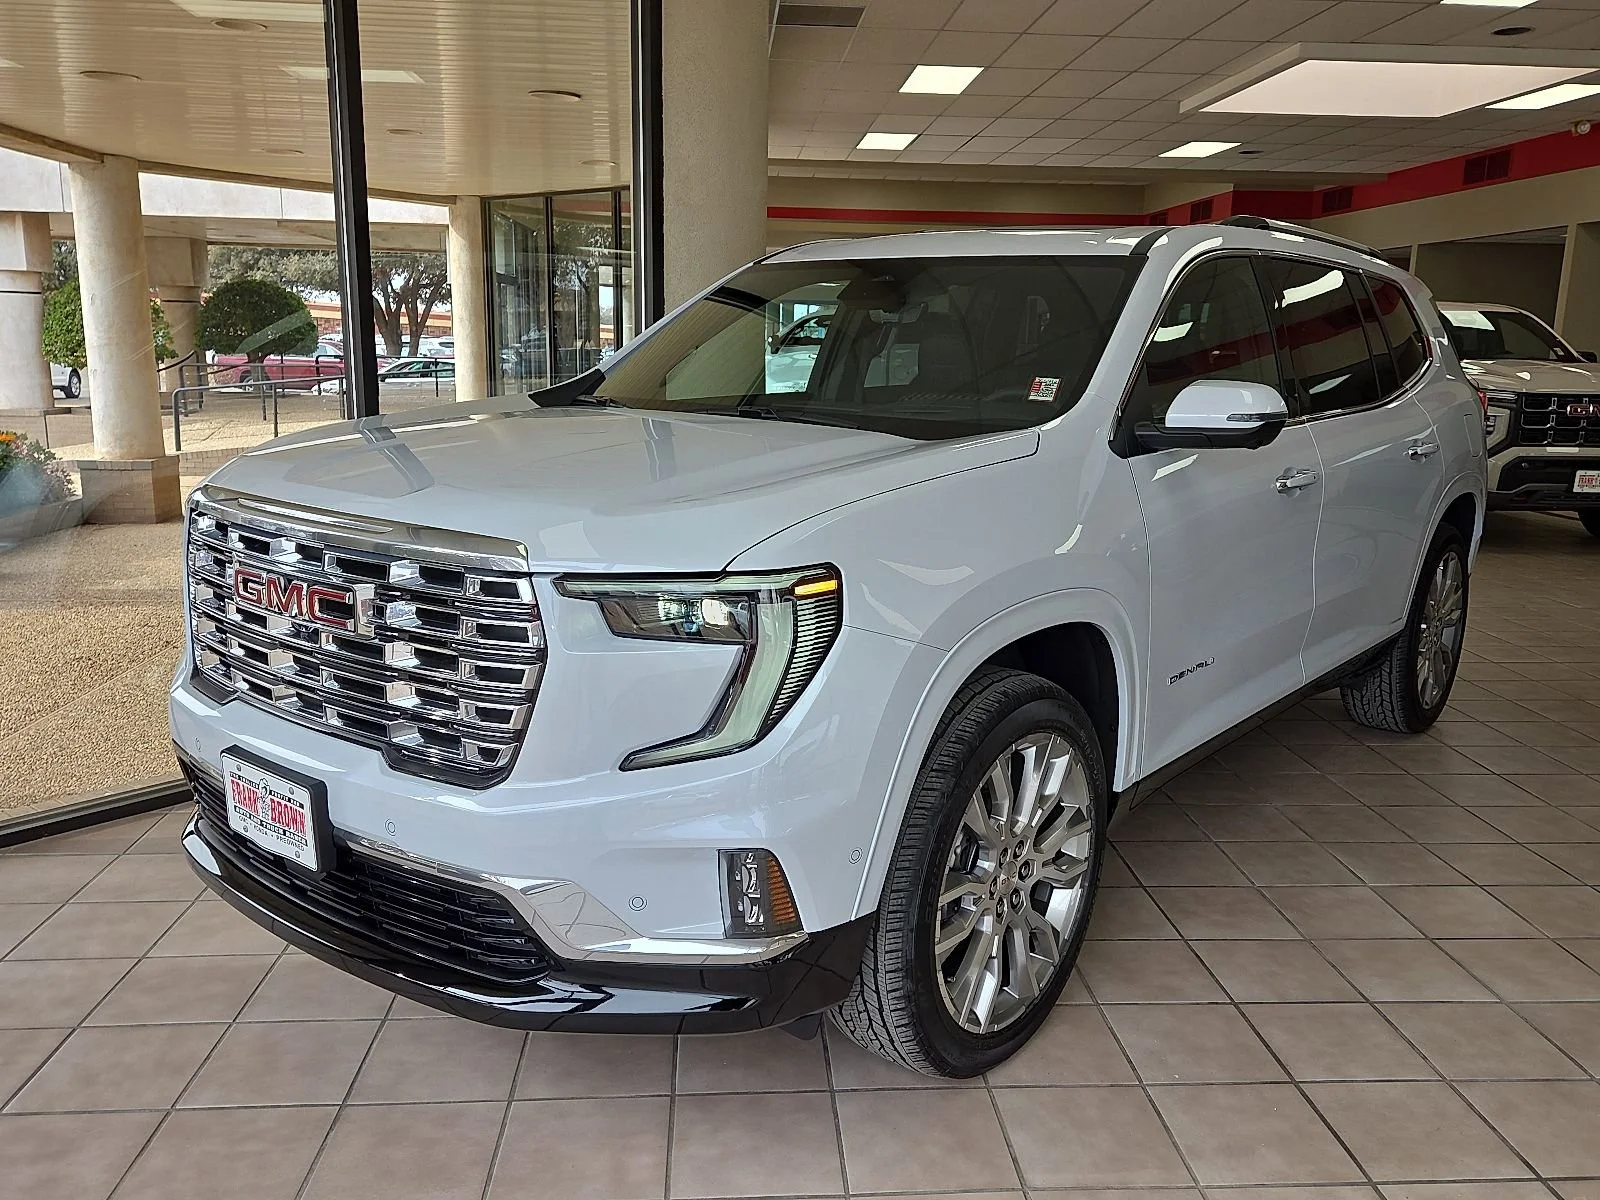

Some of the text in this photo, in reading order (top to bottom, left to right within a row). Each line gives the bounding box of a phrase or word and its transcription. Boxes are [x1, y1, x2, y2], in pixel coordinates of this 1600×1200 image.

[234, 567, 353, 632] GMC
[1167, 656, 1215, 686] DENALI
[230, 779, 307, 837] FRANK BROWN
[262, 820, 284, 835] TRUCK
